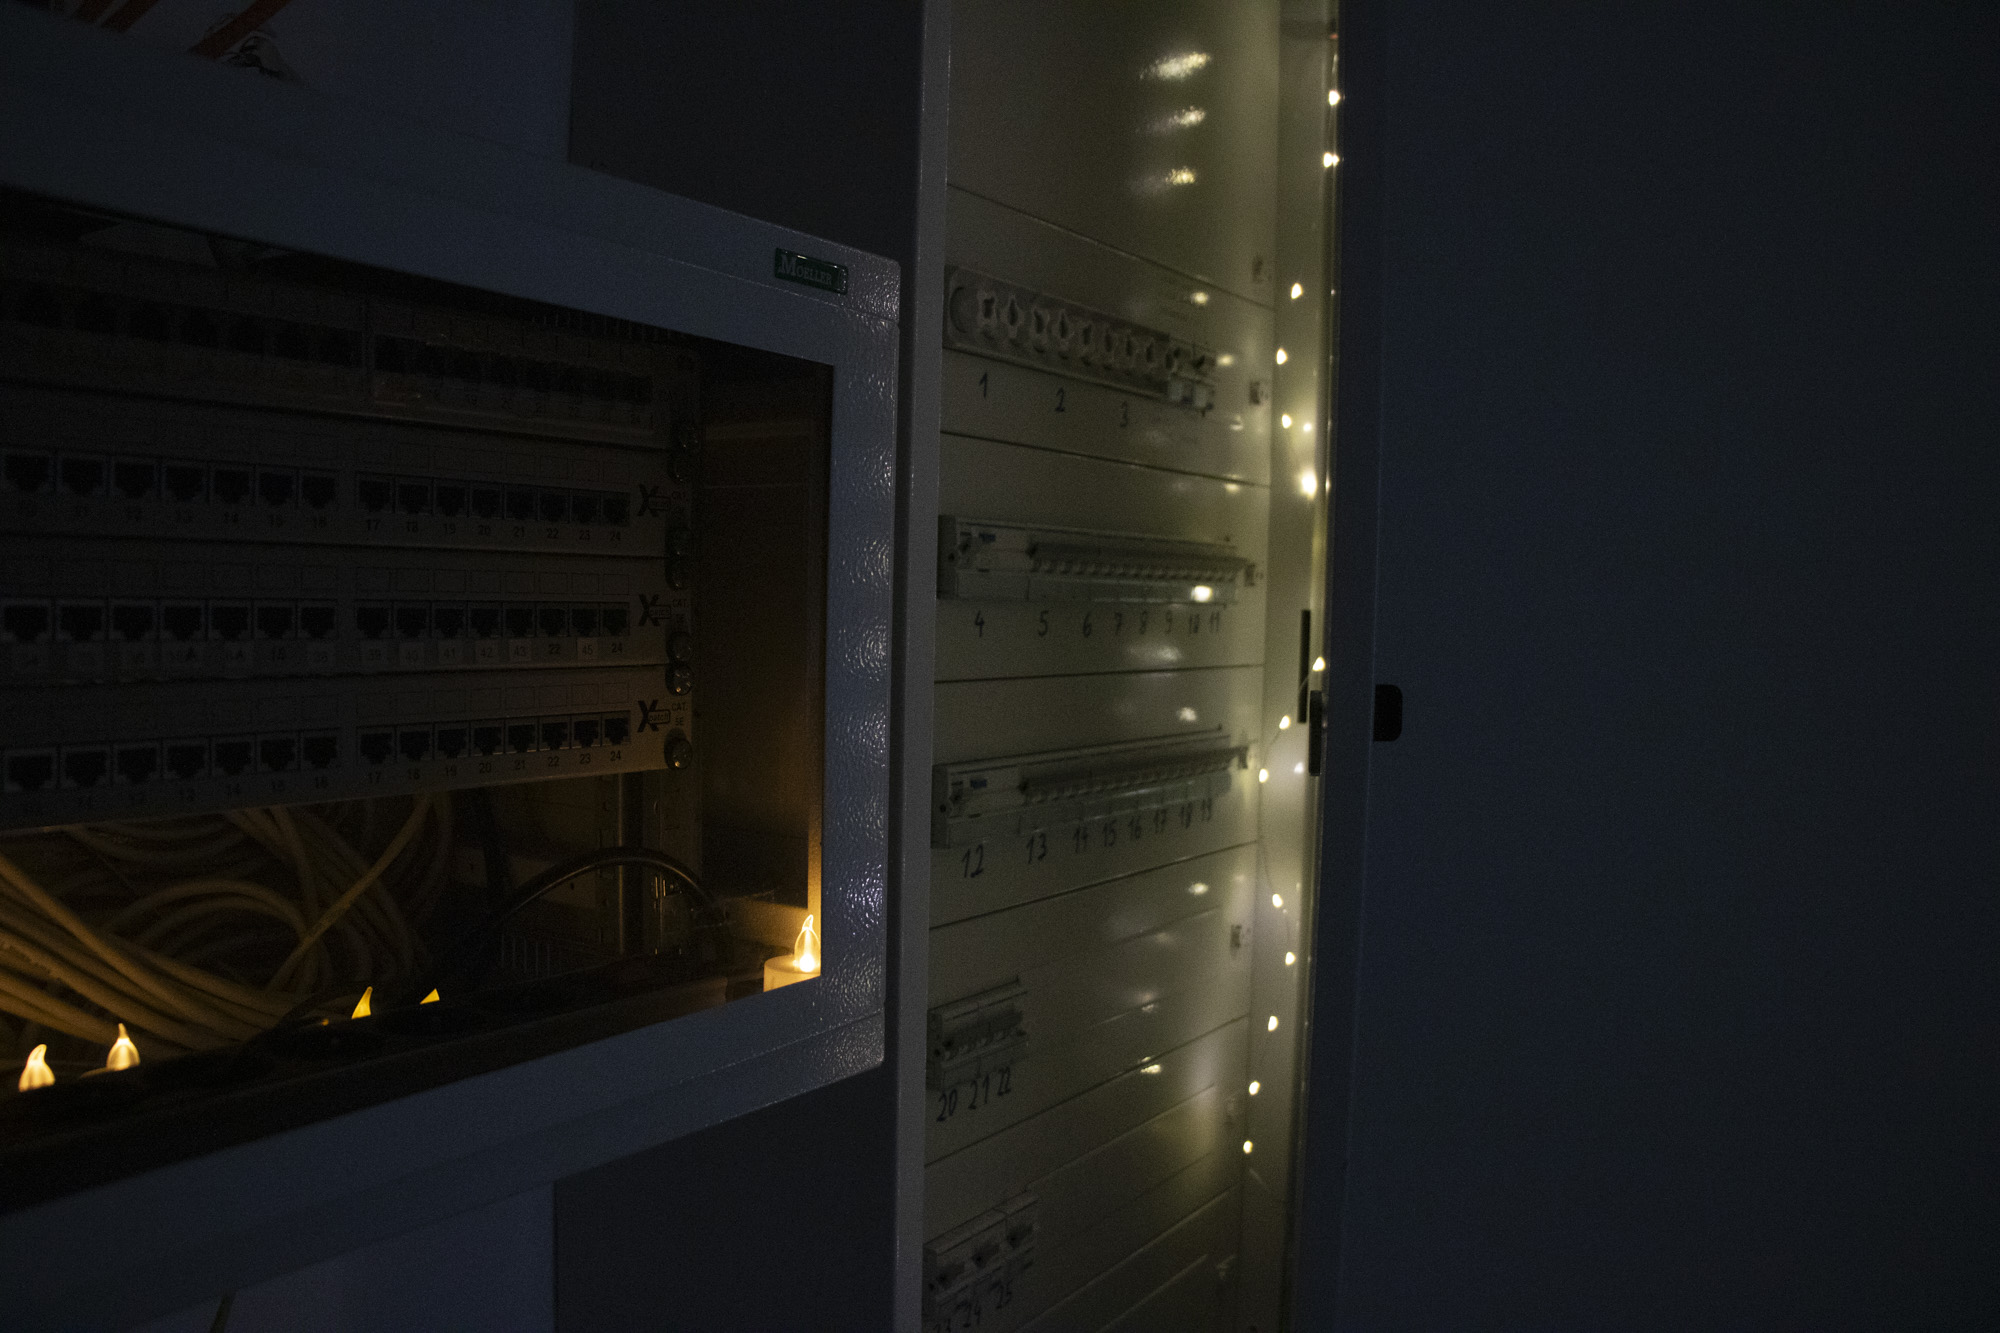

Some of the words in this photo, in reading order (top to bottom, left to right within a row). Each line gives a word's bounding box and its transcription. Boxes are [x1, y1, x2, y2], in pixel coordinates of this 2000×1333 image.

[777, 254, 833, 285] MOELLER
[977, 371, 989, 399] 1
[1054, 387, 1065, 413] 2
[1118, 400, 1130, 429] 3
[366, 519, 380, 532] 17
[406, 521, 419, 534] 18
[443, 523, 456, 535] 19
[478, 525, 491, 537] 20
[513, 526, 525, 538] 21
[546, 527, 559, 540] 22
[579, 529, 591, 541] 23
[609, 530, 622, 543] 24
[974, 610, 985, 638] 4
[1037, 610, 1050, 638] 5
[1082, 610, 1093, 639] 6
[1114, 611, 1123, 636] 7
[1139, 610, 1148, 635] 8
[1165, 610, 1173, 635] 9
[1209, 610, 1221, 634] 11
[480, 646, 494, 658] 42
[513, 645, 526, 656] 43
[582, 644, 593, 656] 45
[611, 642, 623, 653] 24
[368, 771, 381, 784] 17
[407, 768, 420, 780] 18
[444, 765, 457, 777] 19
[479, 761, 492, 774] 20
[514, 759, 526, 770] 21
[547, 756, 560, 767] 22
[579, 753, 591, 765] 23
[610, 750, 622, 762] 24
[961, 843, 985, 879] 12
[1026, 832, 1047, 865] 13
[1073, 825, 1089, 854] 14
[1102, 819, 1117, 847] 15
[1127, 815, 1142, 841] 16
[1153, 808, 1167, 834] 17
[1179, 802, 1192, 829] 18
[936, 1089, 958, 1122] 20
[967, 1074, 990, 1110] 21
[997, 1066, 1011, 1097] 22
[960, 1300, 981, 1328] 24
[995, 1280, 1014, 1310] 25
